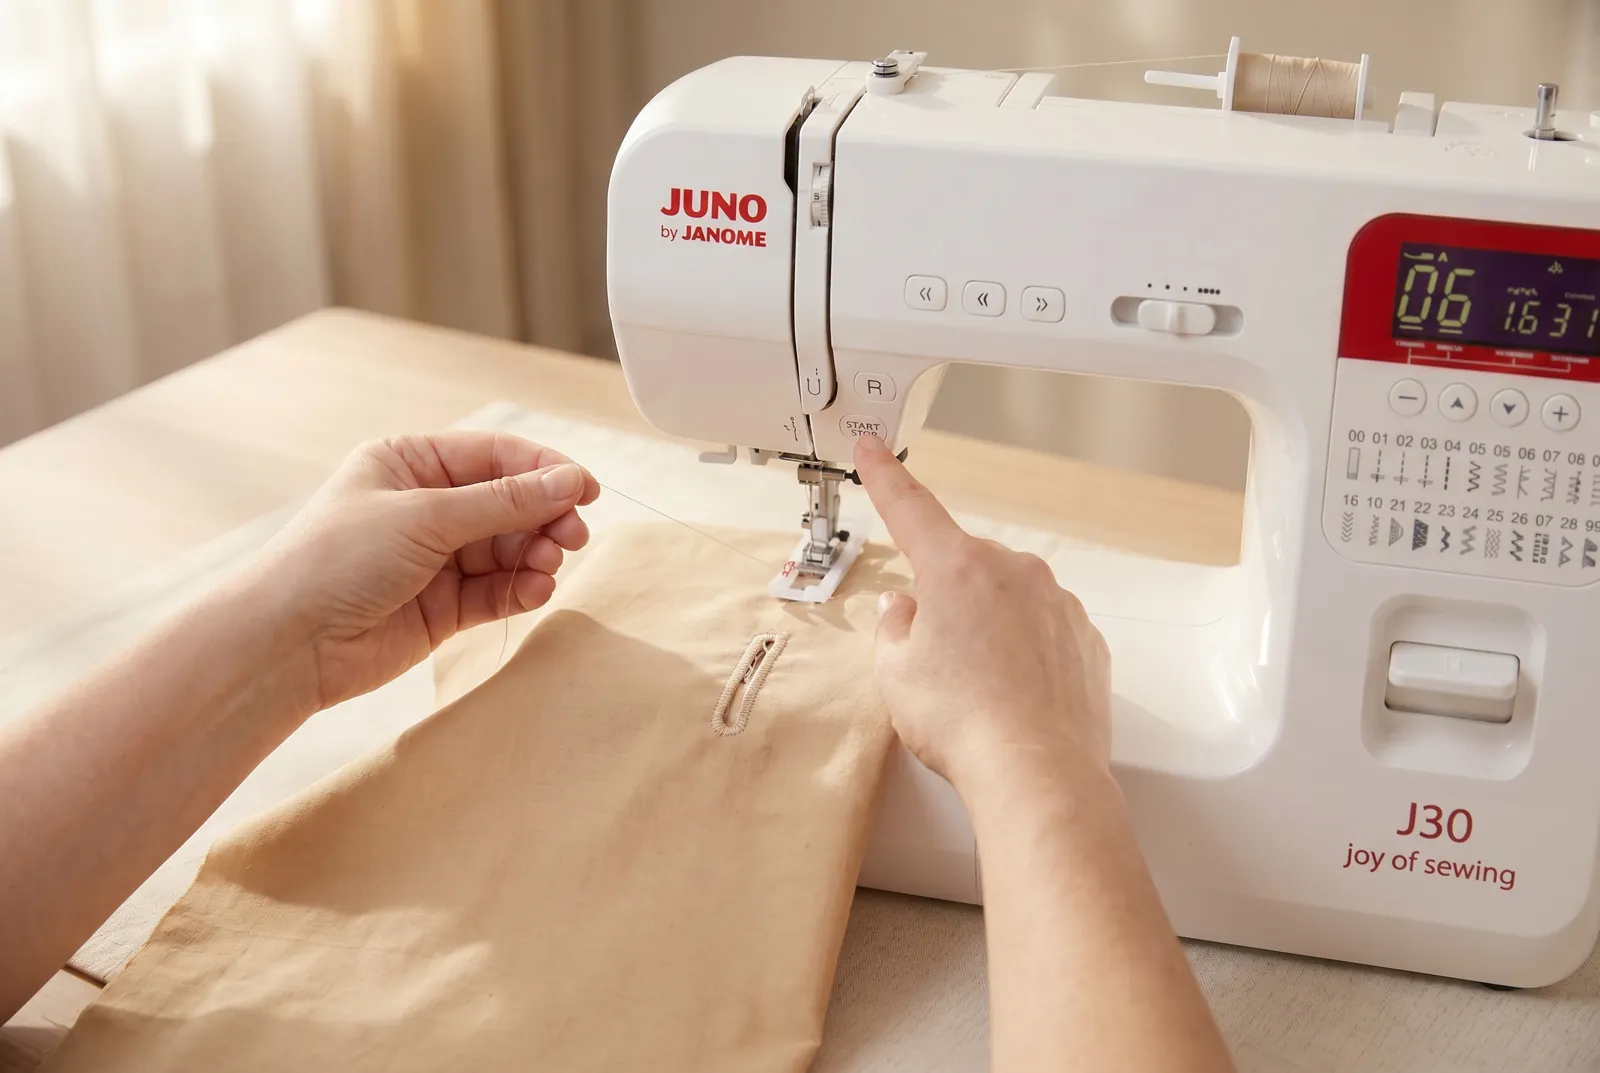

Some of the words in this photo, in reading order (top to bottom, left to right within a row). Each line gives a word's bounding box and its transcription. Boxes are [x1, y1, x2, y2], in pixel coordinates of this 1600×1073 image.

[660, 187, 767, 223] JUNO
[661, 225, 678, 242] by
[682, 225, 767, 247] JANOME
[1397, 264, 1476, 328] 06
[867, 379, 882, 395] R
[846, 420, 880, 431] START
[1348, 430, 1365, 443] 00
[1372, 432, 1388, 445] 01
[1396, 434, 1414, 448] 02
[1420, 437, 1438, 450] 03
[1444, 439, 1461, 452] 04
[1469, 442, 1486, 455] 05
[1493, 444, 1511, 458] 05
[1518, 447, 1536, 460] 06
[1543, 449, 1561, 463] 07
[1567, 452, 1585, 465] 08
[1343, 494, 1359, 507] 16
[1367, 496, 1383, 509] 10
[1390, 498, 1406, 512] 21
[1414, 501, 1431, 514] 22
[1438, 504, 1455, 517] 23
[1462, 506, 1479, 520] 24
[1486, 509, 1504, 522] 25
[1510, 512, 1528, 525] 26
[1535, 514, 1554, 527] 07
[1560, 517, 1578, 530] 28
[1396, 802, 1473, 843] J30
[1343, 843, 1385, 872] joy
[1392, 851, 1420, 872] of
[1424, 859, 1516, 890] sewing
